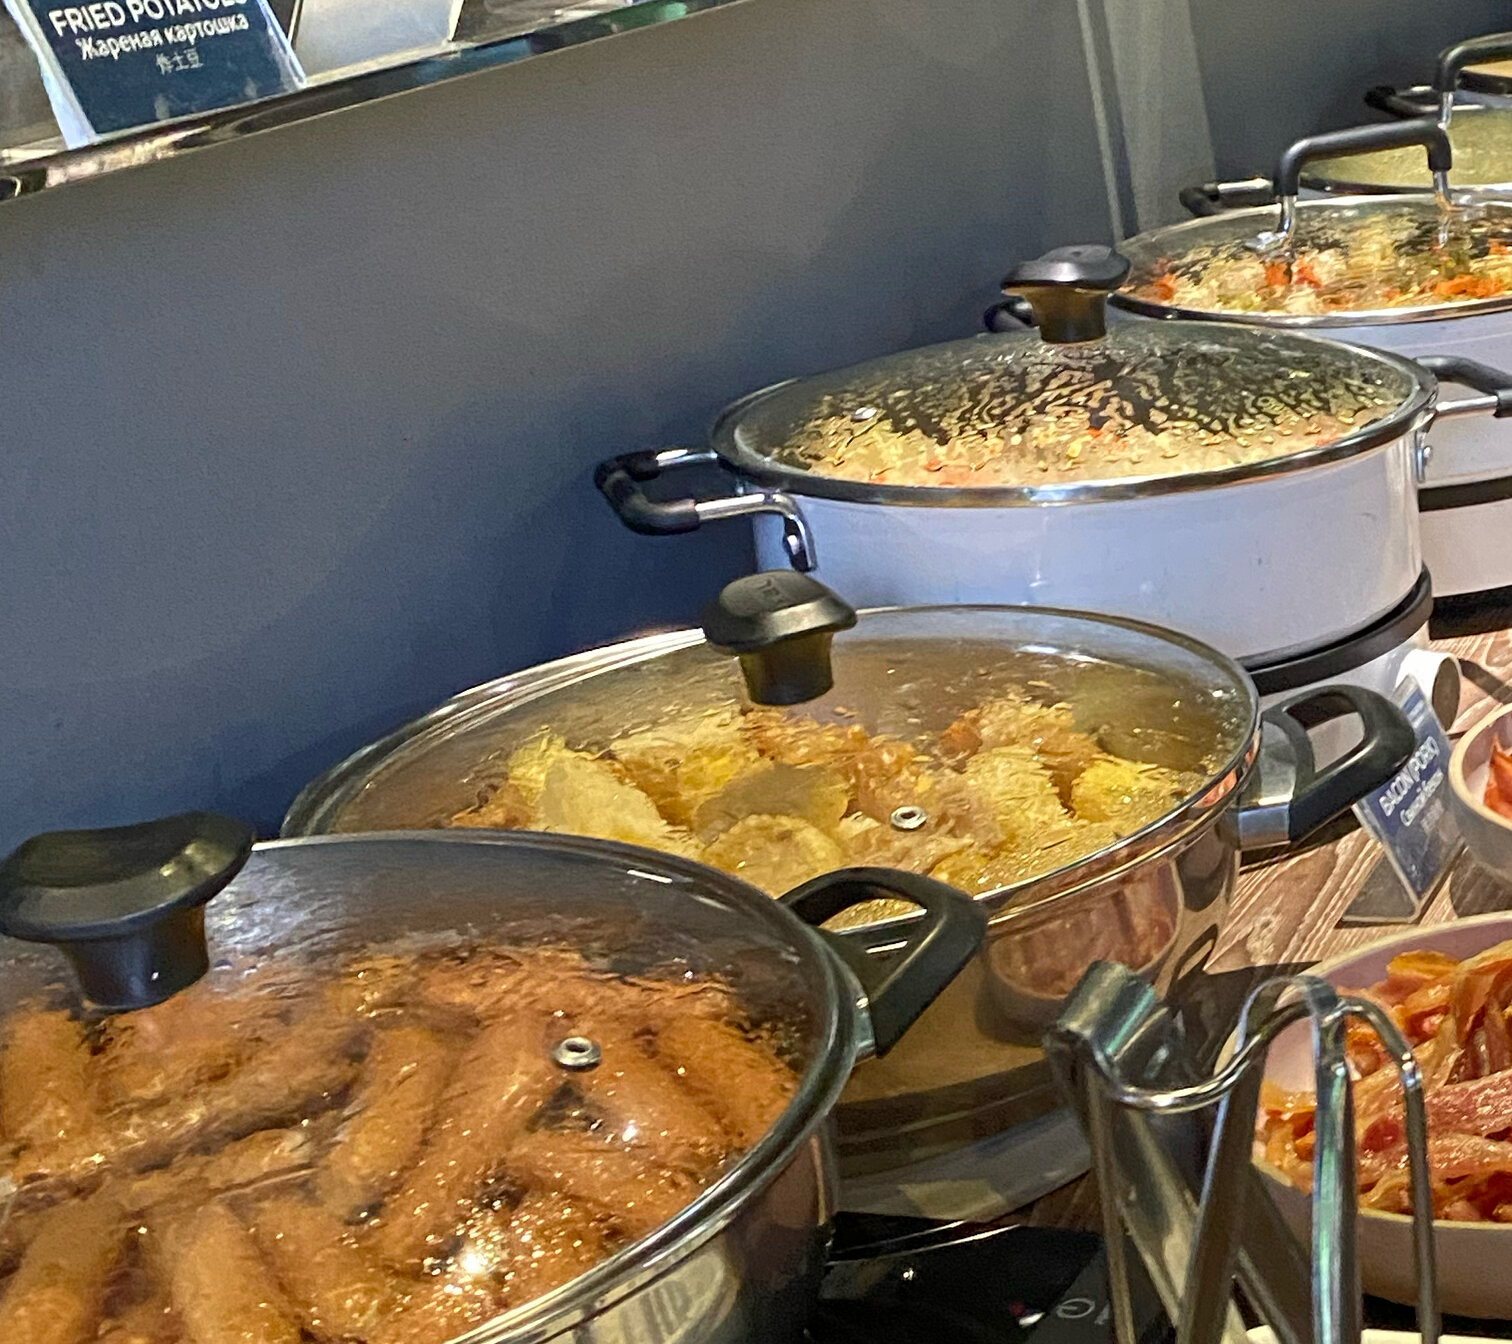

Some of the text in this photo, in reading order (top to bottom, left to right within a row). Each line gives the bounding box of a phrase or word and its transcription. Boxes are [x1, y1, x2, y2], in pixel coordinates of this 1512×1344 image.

[49, 1, 126, 38] FRIED
[76, 13, 249, 61] Жареная картошка
[1379, 768, 1415, 817] BACON
